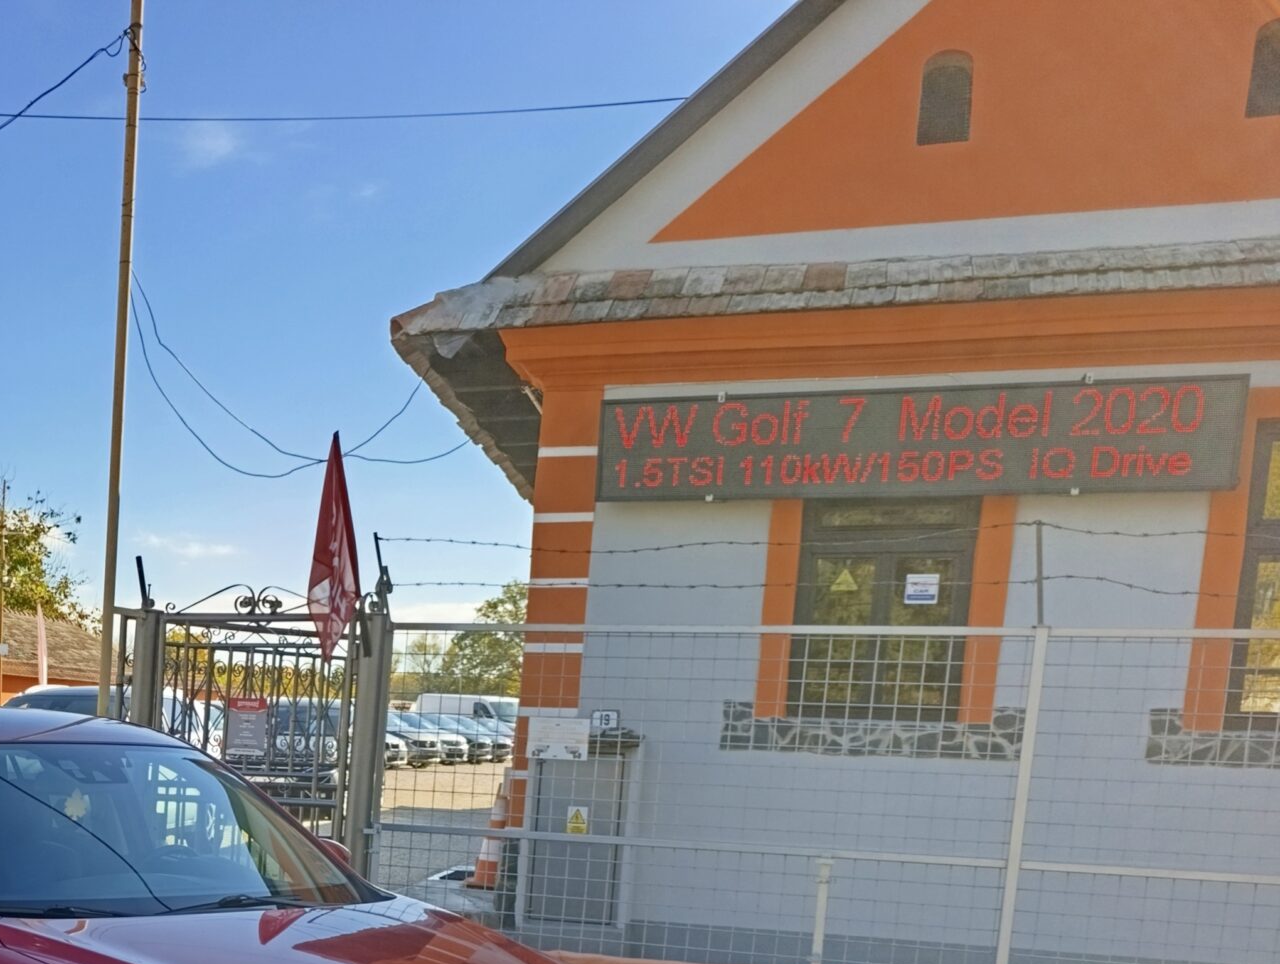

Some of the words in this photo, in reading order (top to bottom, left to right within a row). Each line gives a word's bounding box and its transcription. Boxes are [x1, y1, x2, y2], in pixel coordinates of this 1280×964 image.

[614, 403, 699, 449] VW
[711, 399, 811, 447] Golf
[838, 397, 868, 443] 7
[897, 388, 1054, 442] Model
[1069, 383, 1206, 437] 2020
[614, 455, 725, 488] 1.5TSI
[739, 447, 1005, 487] 110kW/150PS
[1028, 446, 1077, 480] IQ
[1089, 444, 1193, 479] Drive
[599, 712, 611, 727] 19
